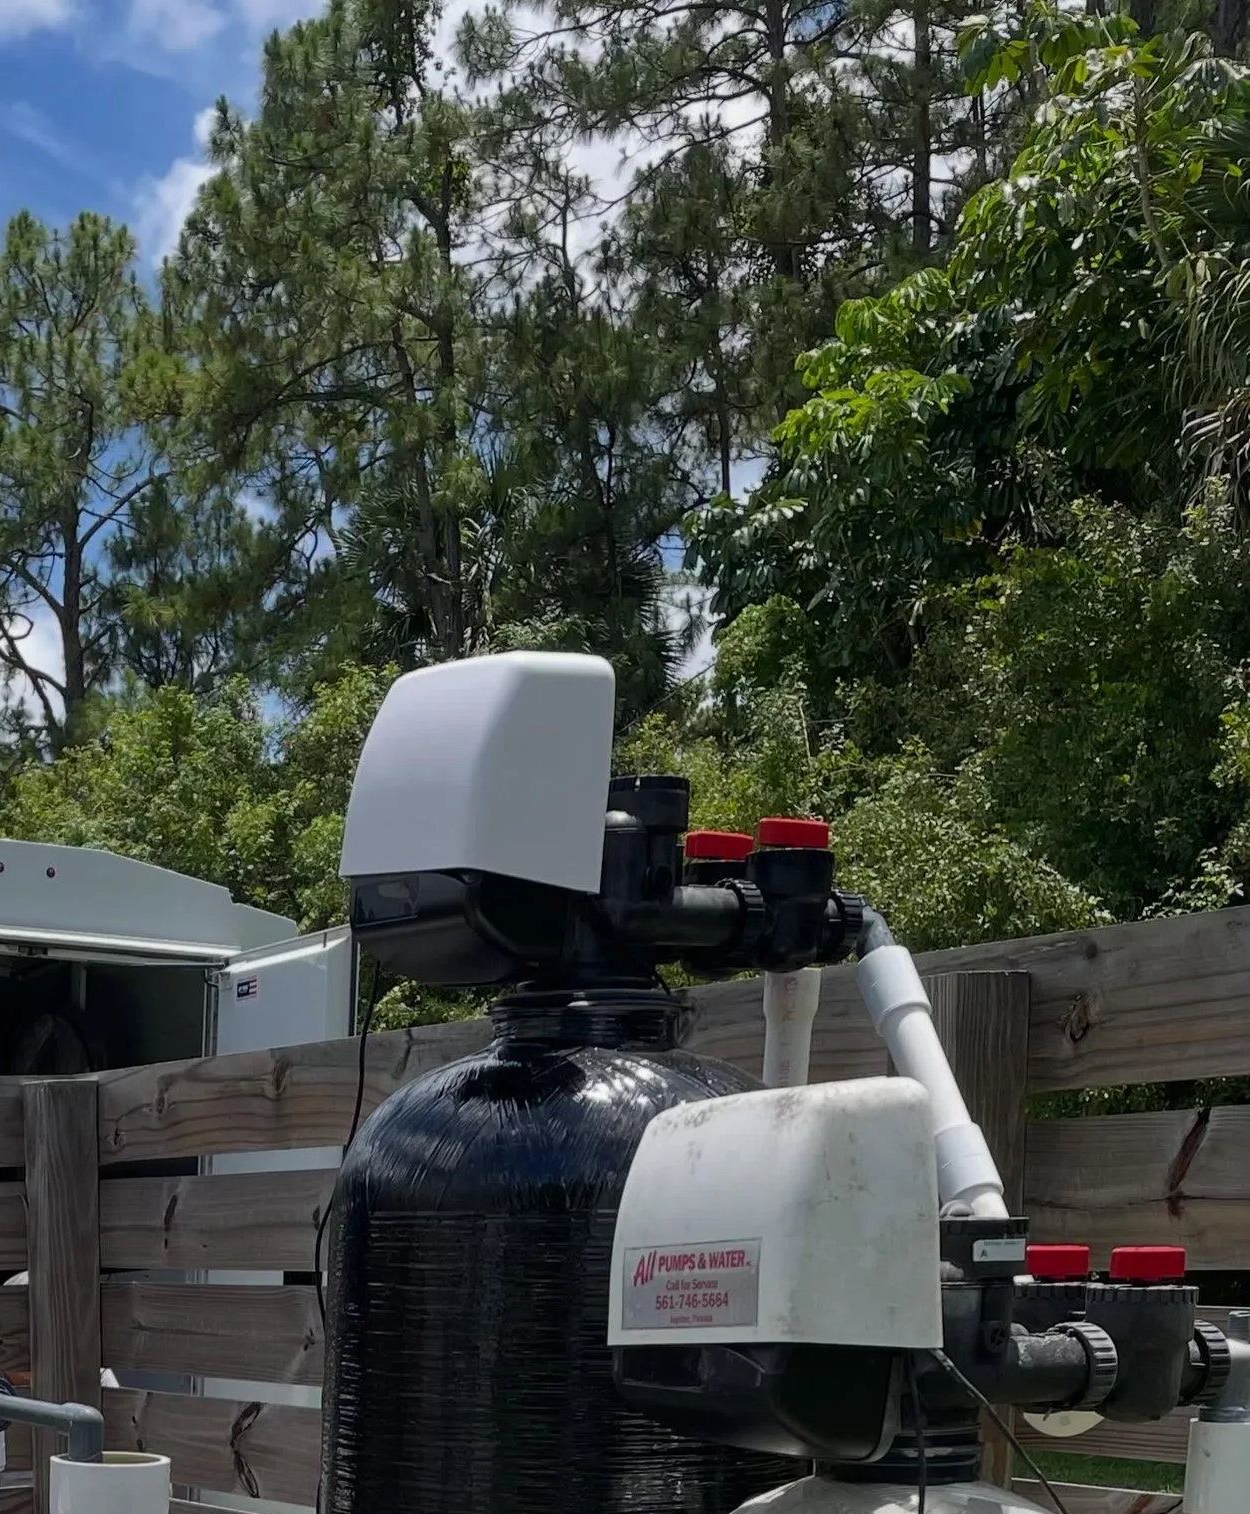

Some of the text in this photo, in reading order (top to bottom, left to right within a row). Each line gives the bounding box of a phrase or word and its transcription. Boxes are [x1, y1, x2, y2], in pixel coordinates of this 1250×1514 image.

[634, 1250, 746, 1287] All PUMPS & WATER
[666, 1280, 680, 1291] Call
[692, 1279, 718, 1290] Service
